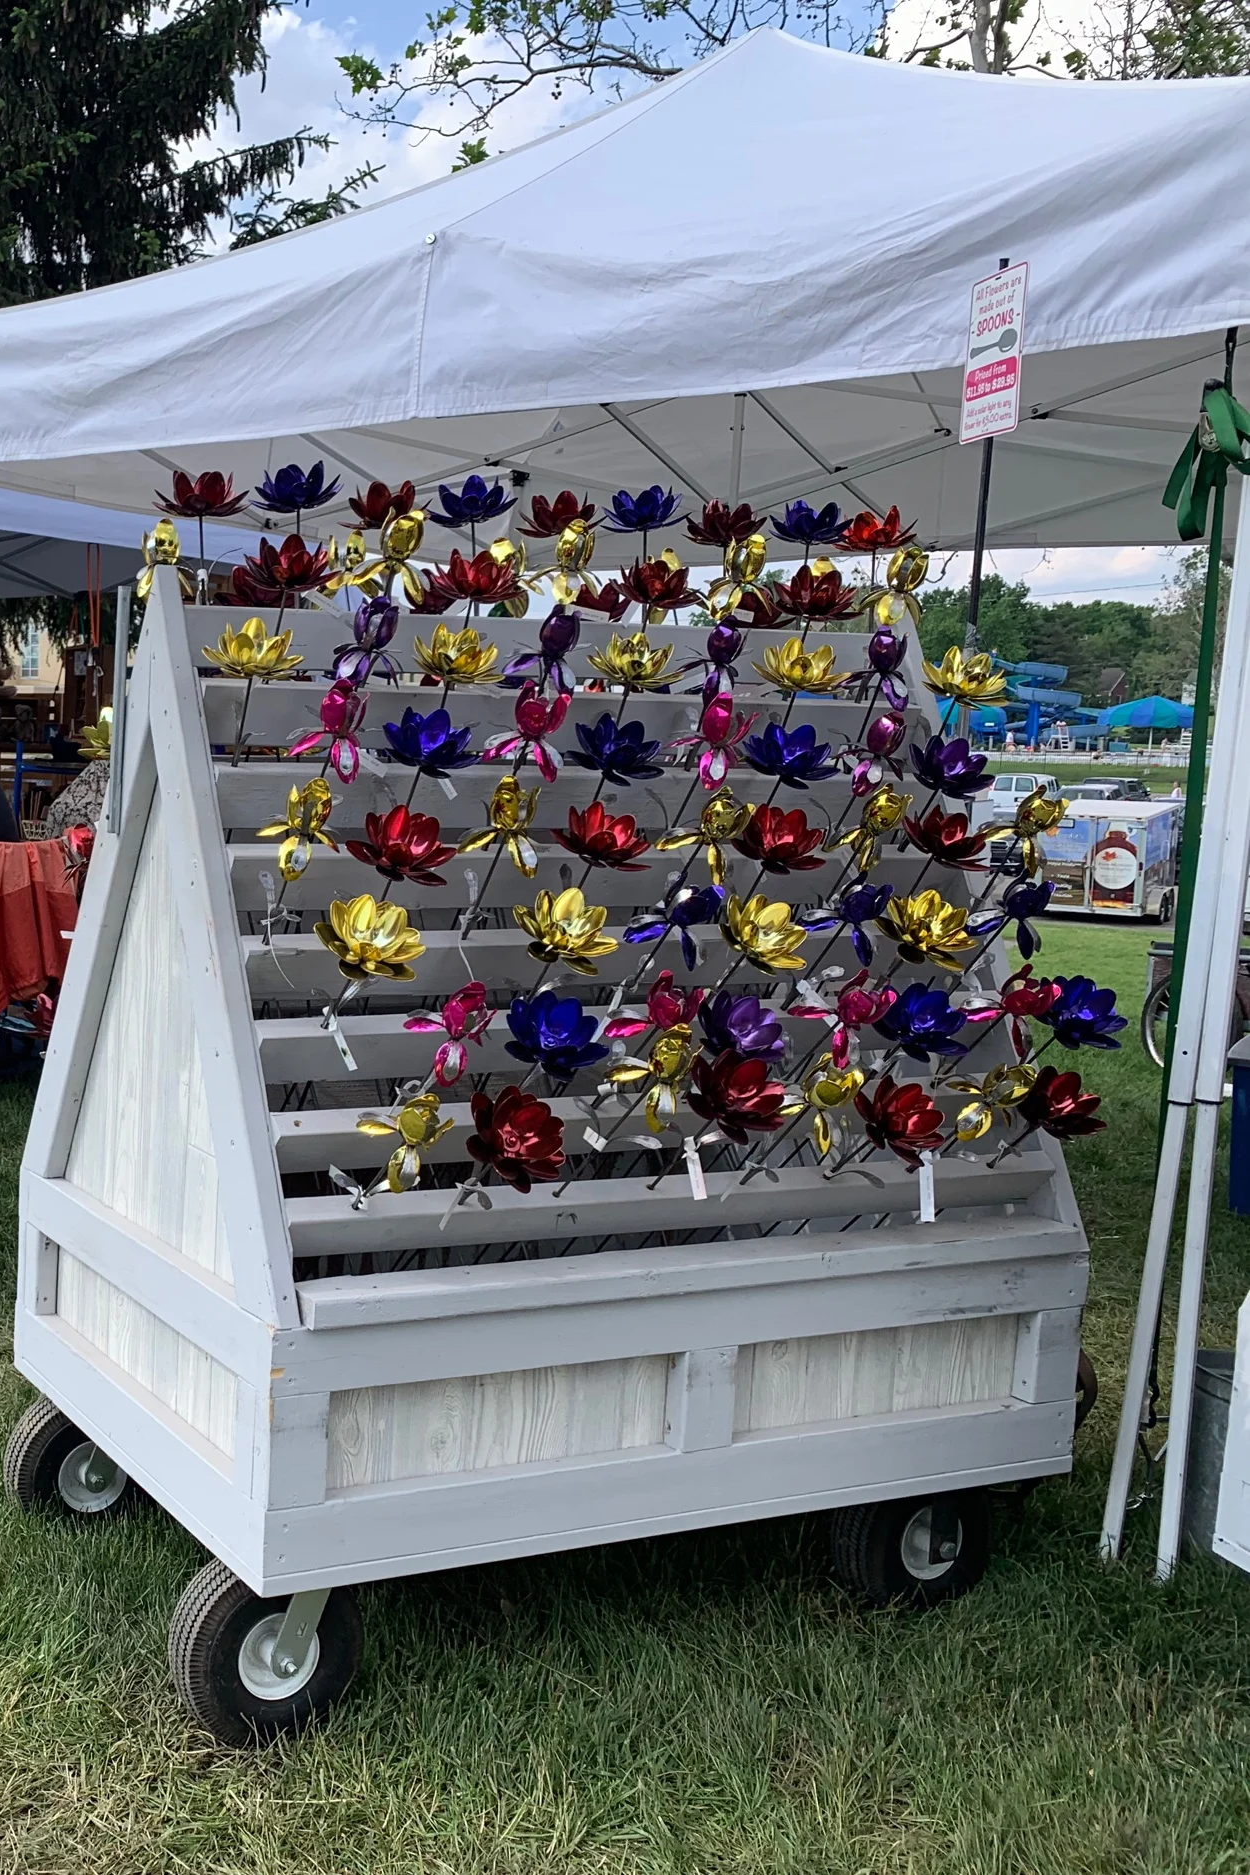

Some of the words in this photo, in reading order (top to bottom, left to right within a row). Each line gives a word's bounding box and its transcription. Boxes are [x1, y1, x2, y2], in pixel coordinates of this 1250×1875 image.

[976, 288, 985, 302] All
[985, 281, 1009, 299] Flowers
[1010, 276, 1022, 288] are
[979, 300, 995, 315] made
[995, 295, 1006, 309] out
[1007, 289, 1016, 303] of
[976, 307, 1015, 337] SPOONS
[993, 363, 1007, 376] from
